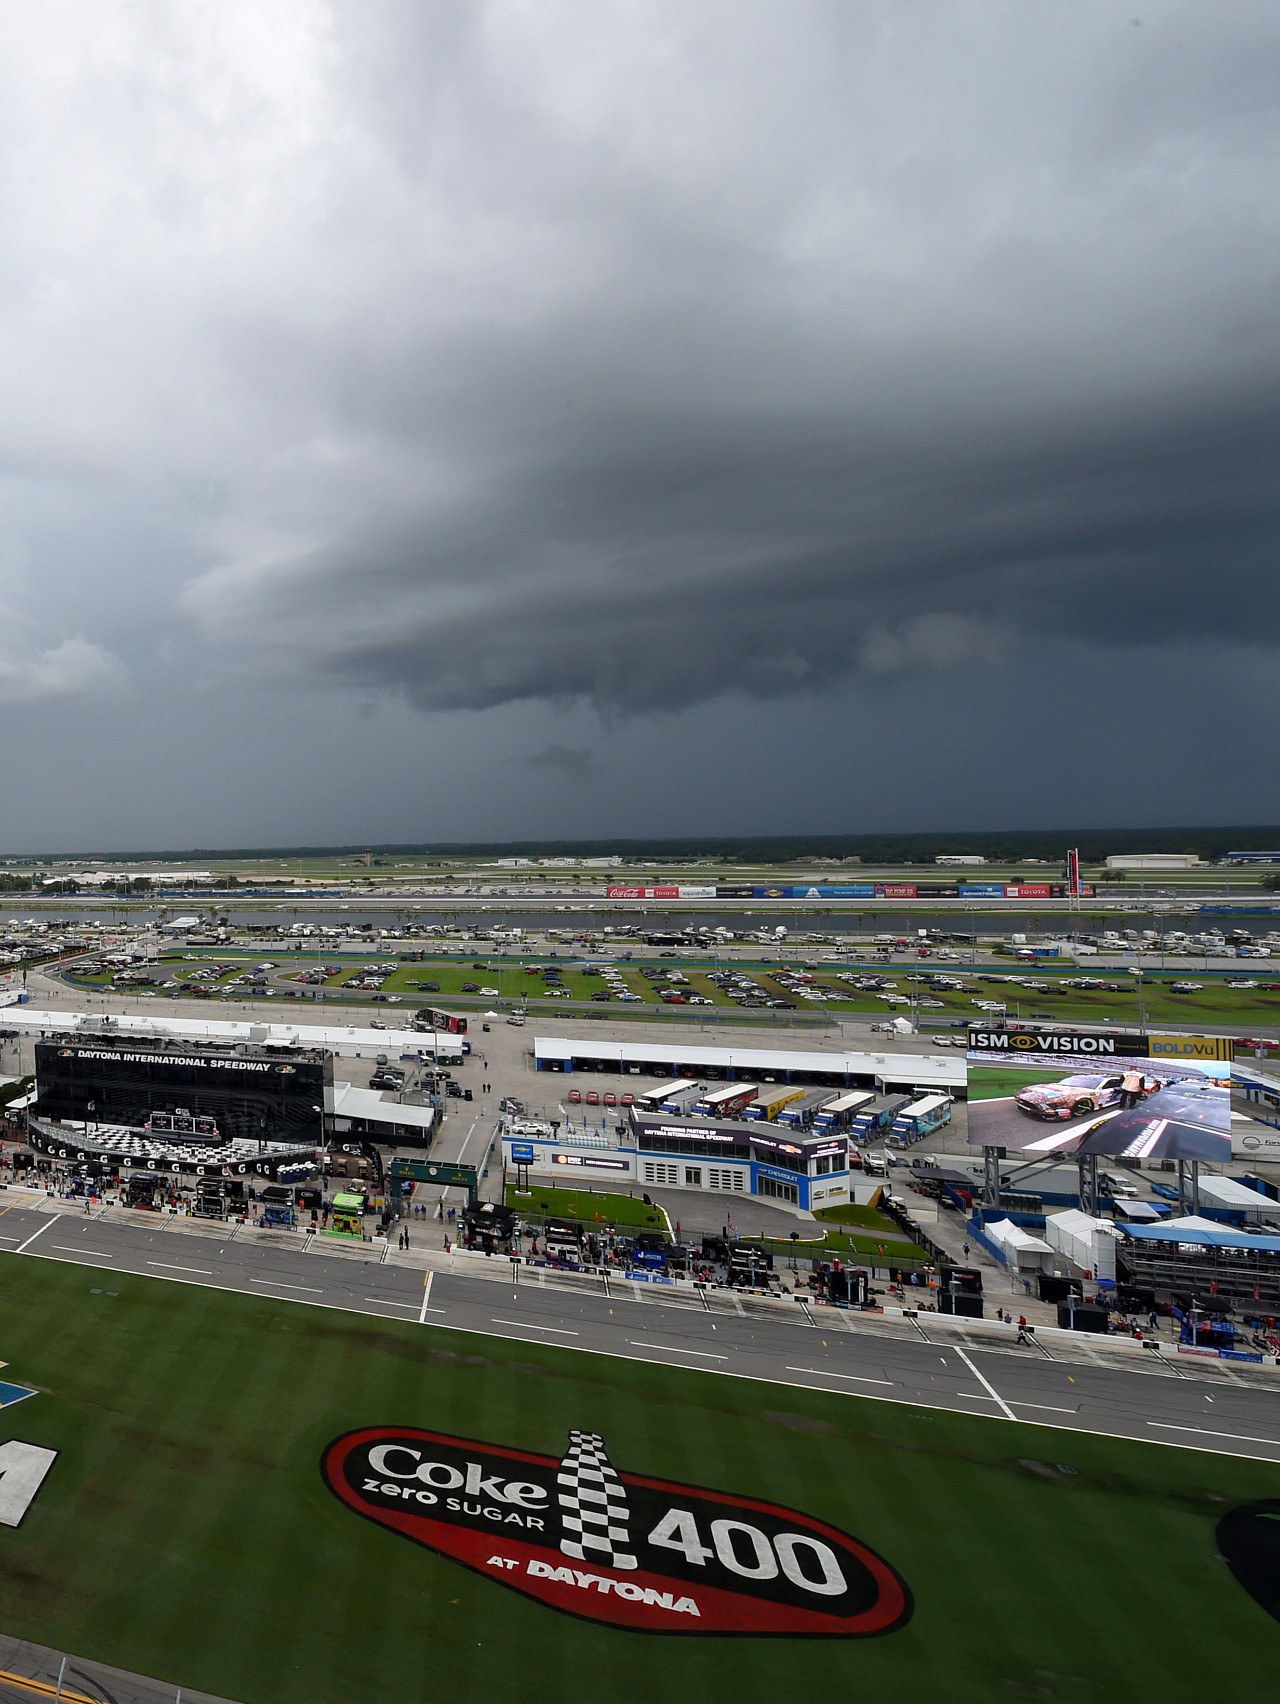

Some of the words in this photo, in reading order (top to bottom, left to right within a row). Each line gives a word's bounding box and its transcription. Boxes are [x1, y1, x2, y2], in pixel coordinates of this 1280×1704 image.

[970, 1033, 1008, 1048] ISM
[1036, 1036, 1115, 1052] VISION
[77, 1050, 121, 1061] DAYTONA
[123, 1053, 207, 1067] INTERNATIONAL
[210, 1059, 271, 1072] SPEEDWAY
[667, 1131, 705, 1139] INTERNATIONAL
[749, 1136, 776, 1148] CHEVROLET
[48, 1145, 55, 1154] G
[59, 1149, 66, 1157] G
[77, 1152, 84, 1160] G
[100, 1155, 107, 1163] G
[124, 1158, 131, 1166] G
[147, 1161, 155, 1169] G
[172, 1163, 179, 1172] G
[197, 1166, 205, 1175] G
[239, 1164, 245, 1173] G
[256, 1163, 261, 1172] G
[264, 1165, 269, 1174] G
[767, 1169, 798, 1182] CHEVROLET
[368, 1444, 550, 1510] Coke
[362, 1478, 438, 1505] zero
[446, 1497, 545, 1531] SUGAR
[647, 1508, 848, 1596] 400
[486, 1555, 520, 1570] AT
[526, 1559, 701, 1617] DAYTONA
